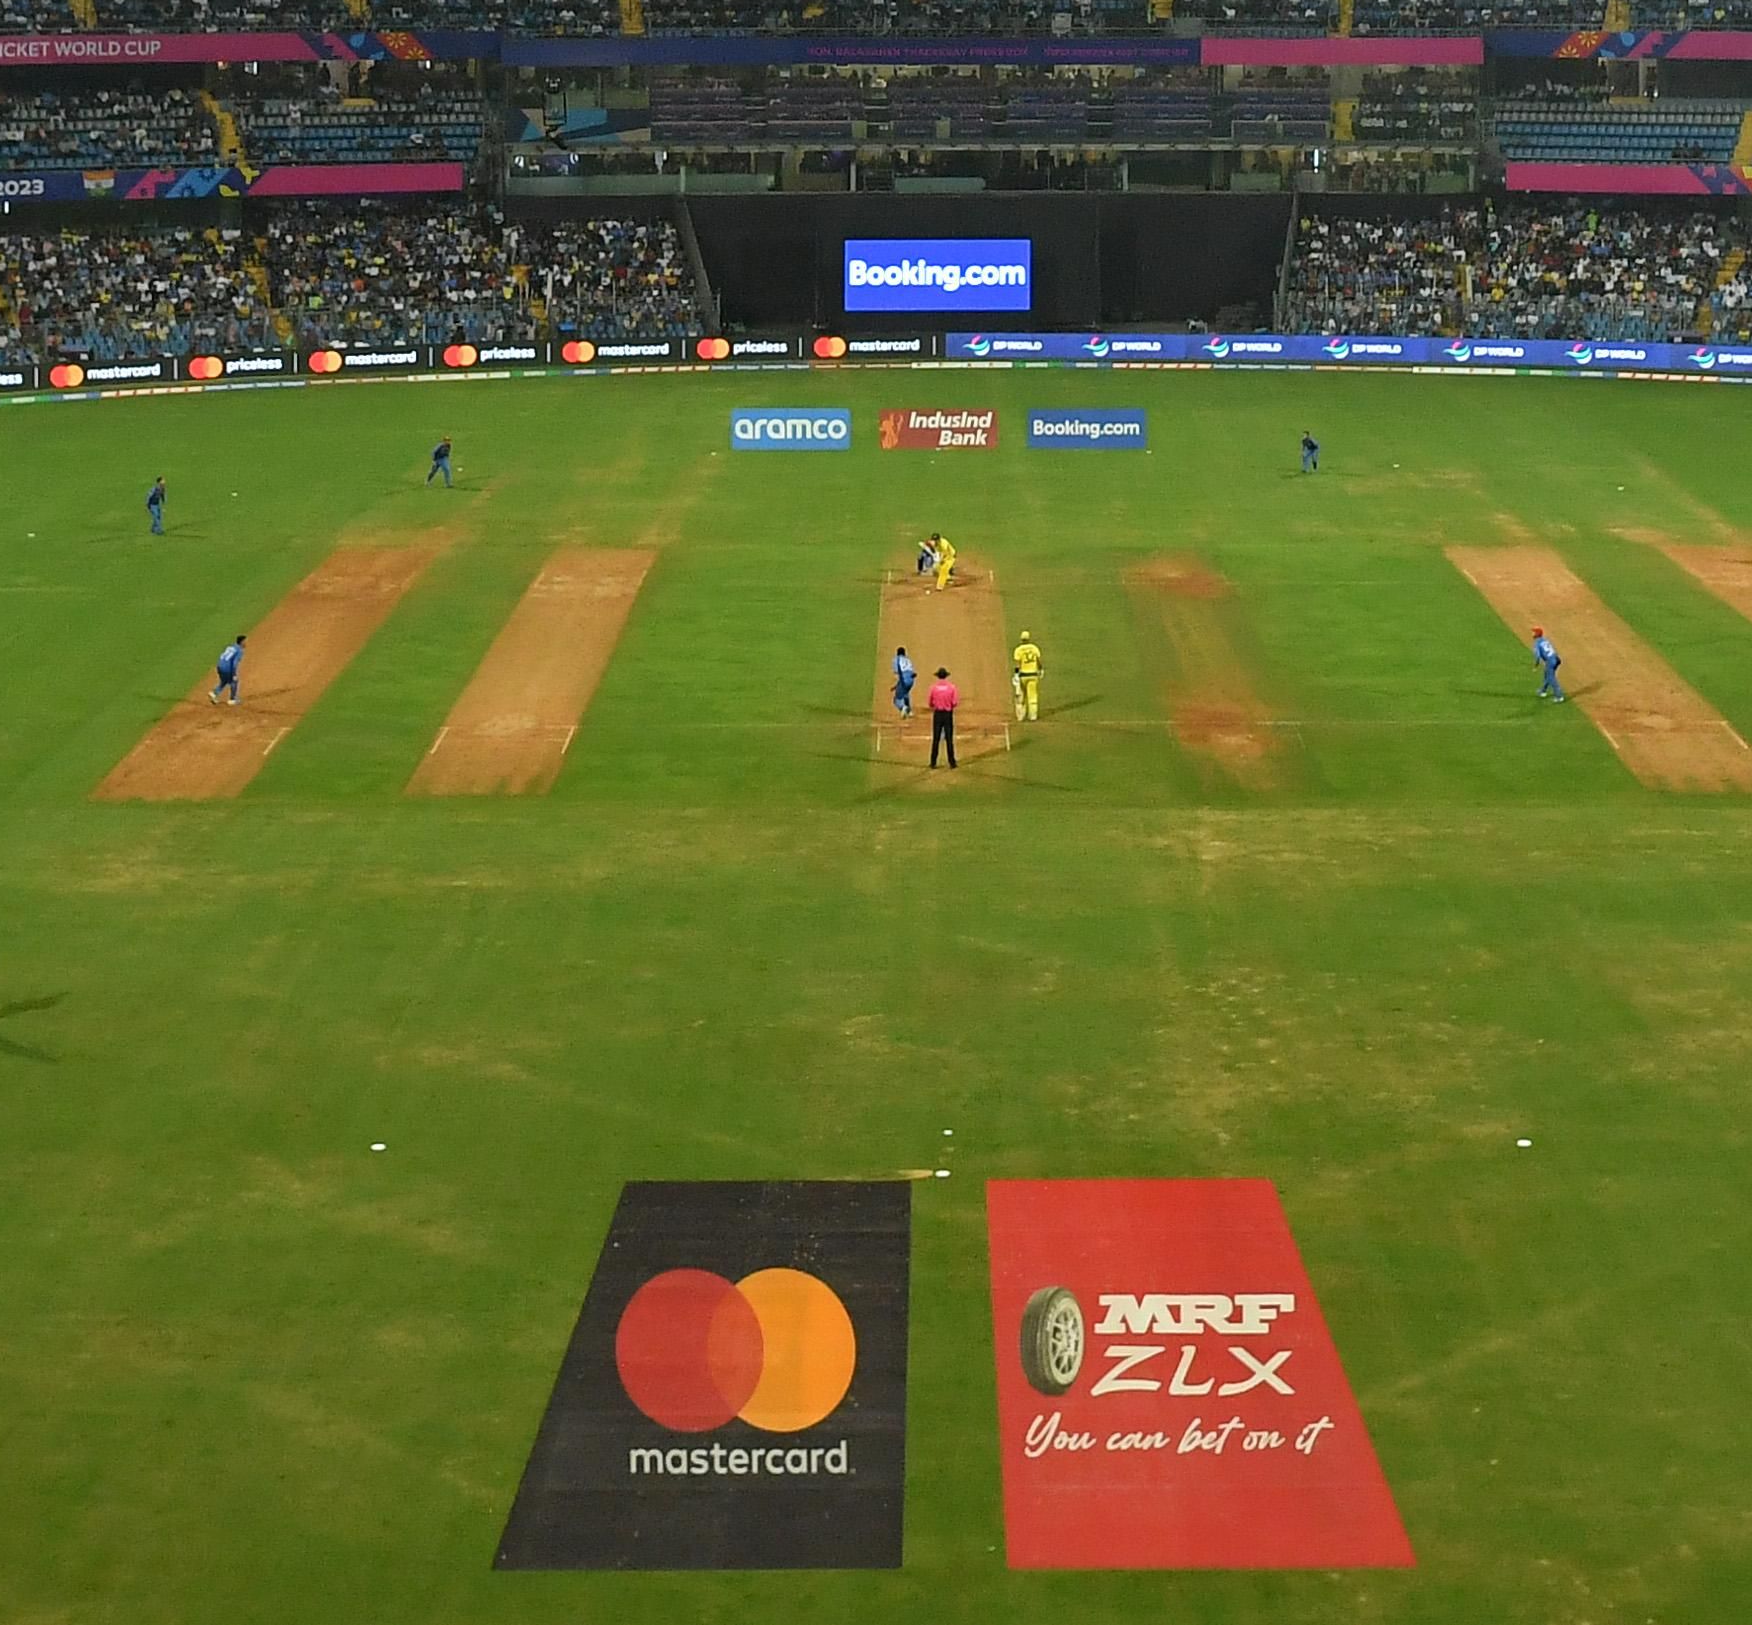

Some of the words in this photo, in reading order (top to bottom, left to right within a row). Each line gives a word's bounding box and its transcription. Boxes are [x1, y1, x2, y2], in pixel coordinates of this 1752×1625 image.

[54, 41, 121, 57] WORLD
[125, 40, 161, 56] CUP
[848, 259, 1027, 292] Booking.com
[597, 342, 670, 357] mastercard
[732, 340, 788, 356] priceless
[848, 338, 921, 352] mastercard
[1007, 340, 1043, 351] WORLD
[1126, 341, 1162, 352] WORLD
[1247, 342, 1283, 353] WORLD
[1367, 344, 1402, 354] WORLD
[1488, 346, 1525, 358] WORLD
[344, 350, 418, 367] mastercard
[479, 346, 536, 363] priceless
[1610, 349, 1647, 361] WORLD
[86, 362, 161, 380] mastercard
[225, 357, 283, 374] priceless
[909, 412, 993, 429] IndusInd
[1032, 419, 1141, 438] Booking.com
[734, 419, 847, 440] aramco
[939, 430, 987, 446] Bank
[1094, 1294, 1295, 1335] MRF
[1090, 1345, 1295, 1396] ZLX
[1024, 1412, 1097, 1458] You
[1106, 1429, 1170, 1451] can
[1177, 1416, 1246, 1455] bet
[1243, 1429, 1286, 1451] on
[1295, 1415, 1335, 1455] it
[629, 1440, 848, 1474] mastercard
